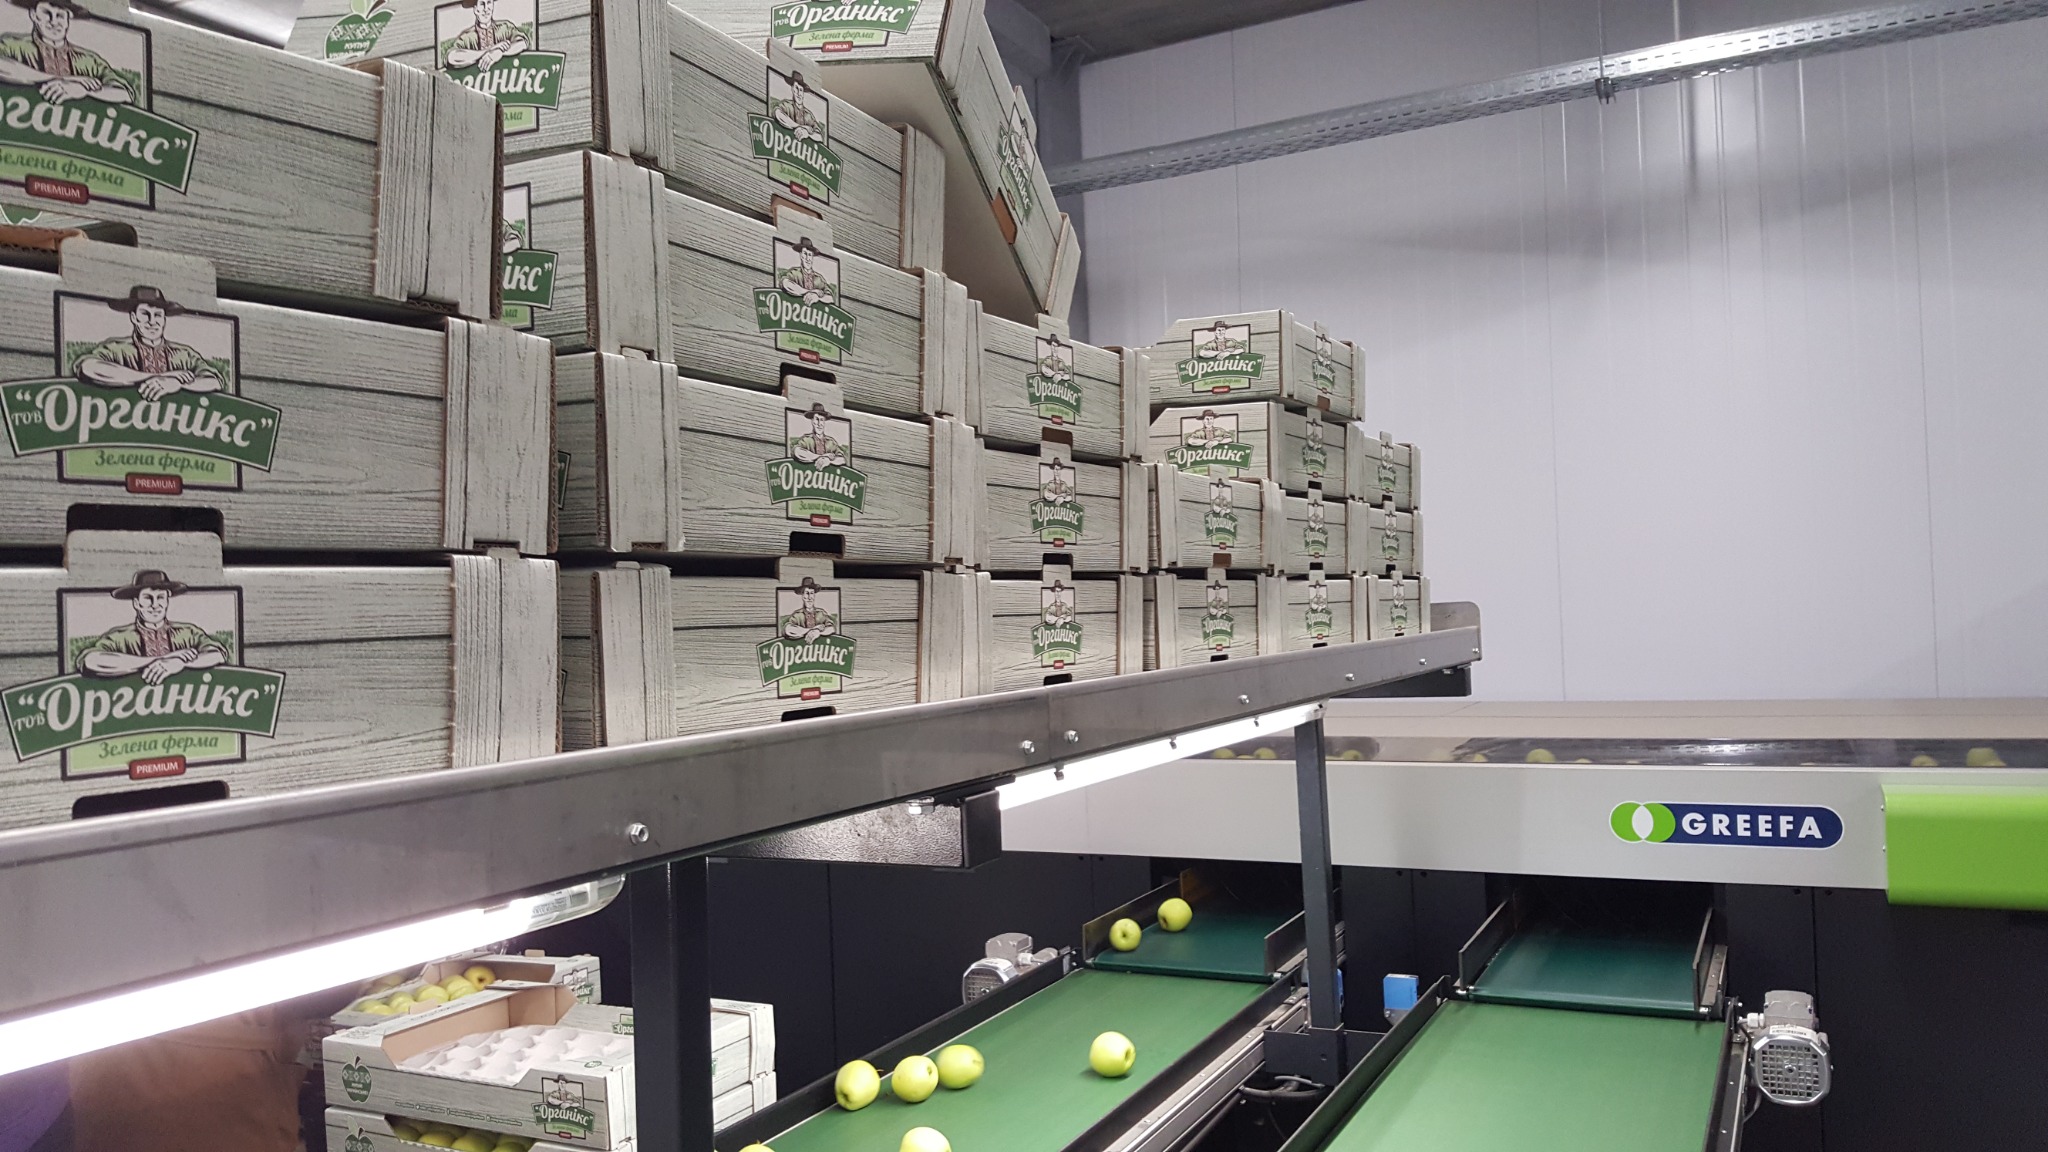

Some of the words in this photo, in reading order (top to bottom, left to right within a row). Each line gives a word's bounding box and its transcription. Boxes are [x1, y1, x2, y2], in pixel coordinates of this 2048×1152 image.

[0, 96, 188, 166] ганікс”
[0, 148, 57, 171] елена
[61, 160, 124, 187] ферма
[754, 120, 841, 179] “Органікс”
[34, 182, 80, 198] PREMIUM
[760, 292, 852, 339] “Органікс”
[16, 384, 273, 447] “Органікс”
[95, 450, 156, 467] Зелена
[159, 453, 215, 473] ферма
[135, 478, 176, 489] PREMIUM
[771, 462, 864, 499] “Органікс”
[763, 638, 854, 674] “Органікс”
[18, 672, 276, 739] “Органікс”
[99, 739, 158, 759] Зелена
[162, 735, 219, 754] ферма
[136, 762, 178, 774] PREMIUM
[1681, 812, 1822, 839] GREEFA
